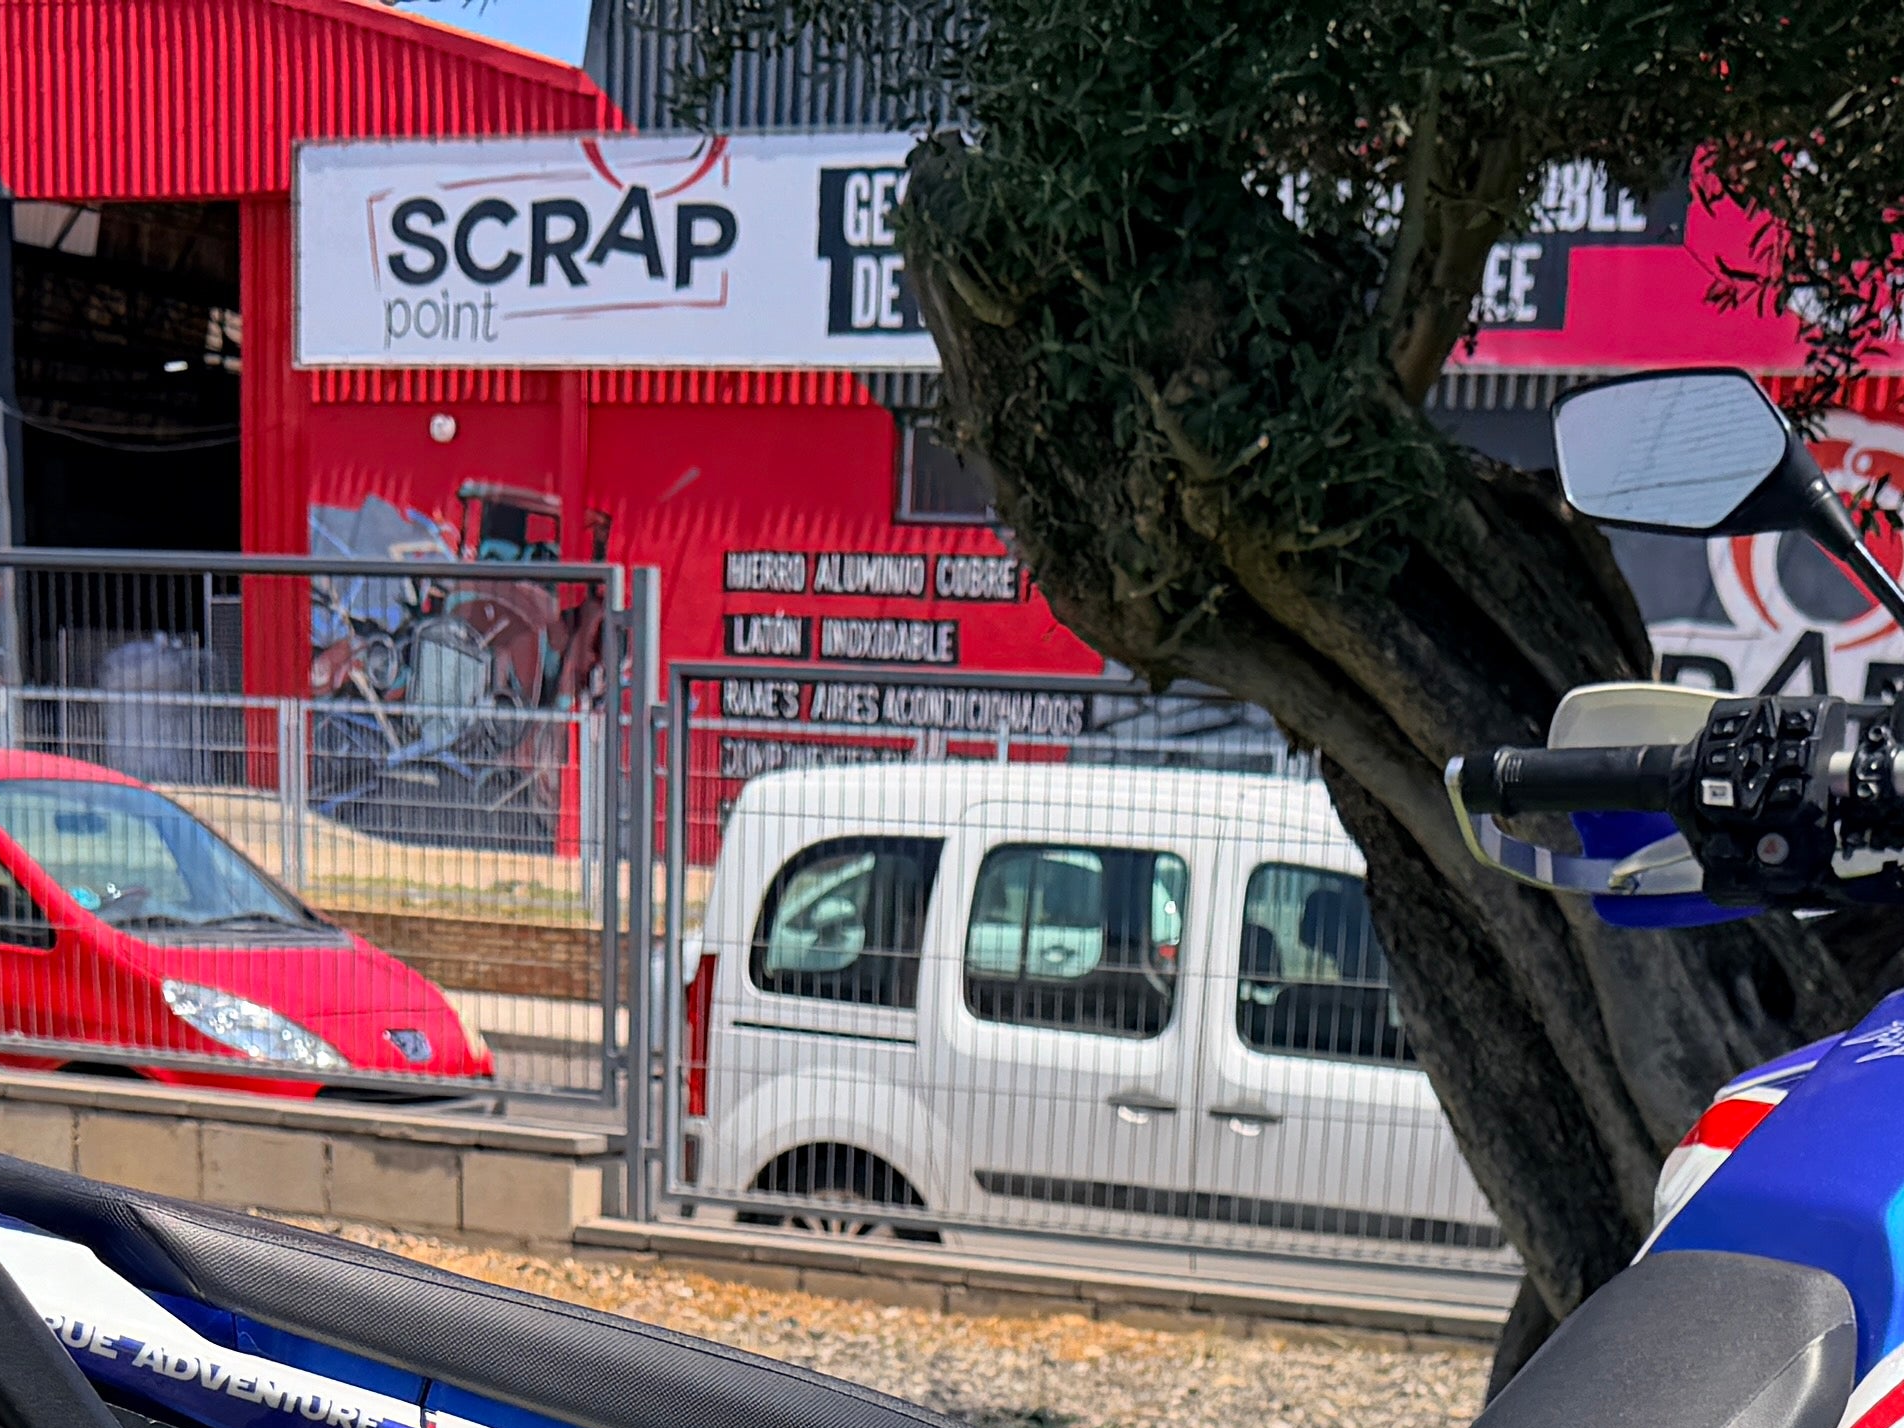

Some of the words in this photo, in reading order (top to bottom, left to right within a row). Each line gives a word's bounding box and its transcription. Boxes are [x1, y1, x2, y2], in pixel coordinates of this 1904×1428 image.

[843, 170, 912, 246] GE
[388, 184, 738, 290] SCRAP
[851, 255, 905, 328] DE
[384, 288, 498, 350] point
[726, 553, 806, 592] HIERRO
[813, 554, 926, 596] ALUMINIO
[936, 556, 1018, 599] COBRE
[821, 616, 956, 663] INOXIDABLE
[809, 682, 879, 725] AIRES
[45, 1314, 118, 1359] RUE
